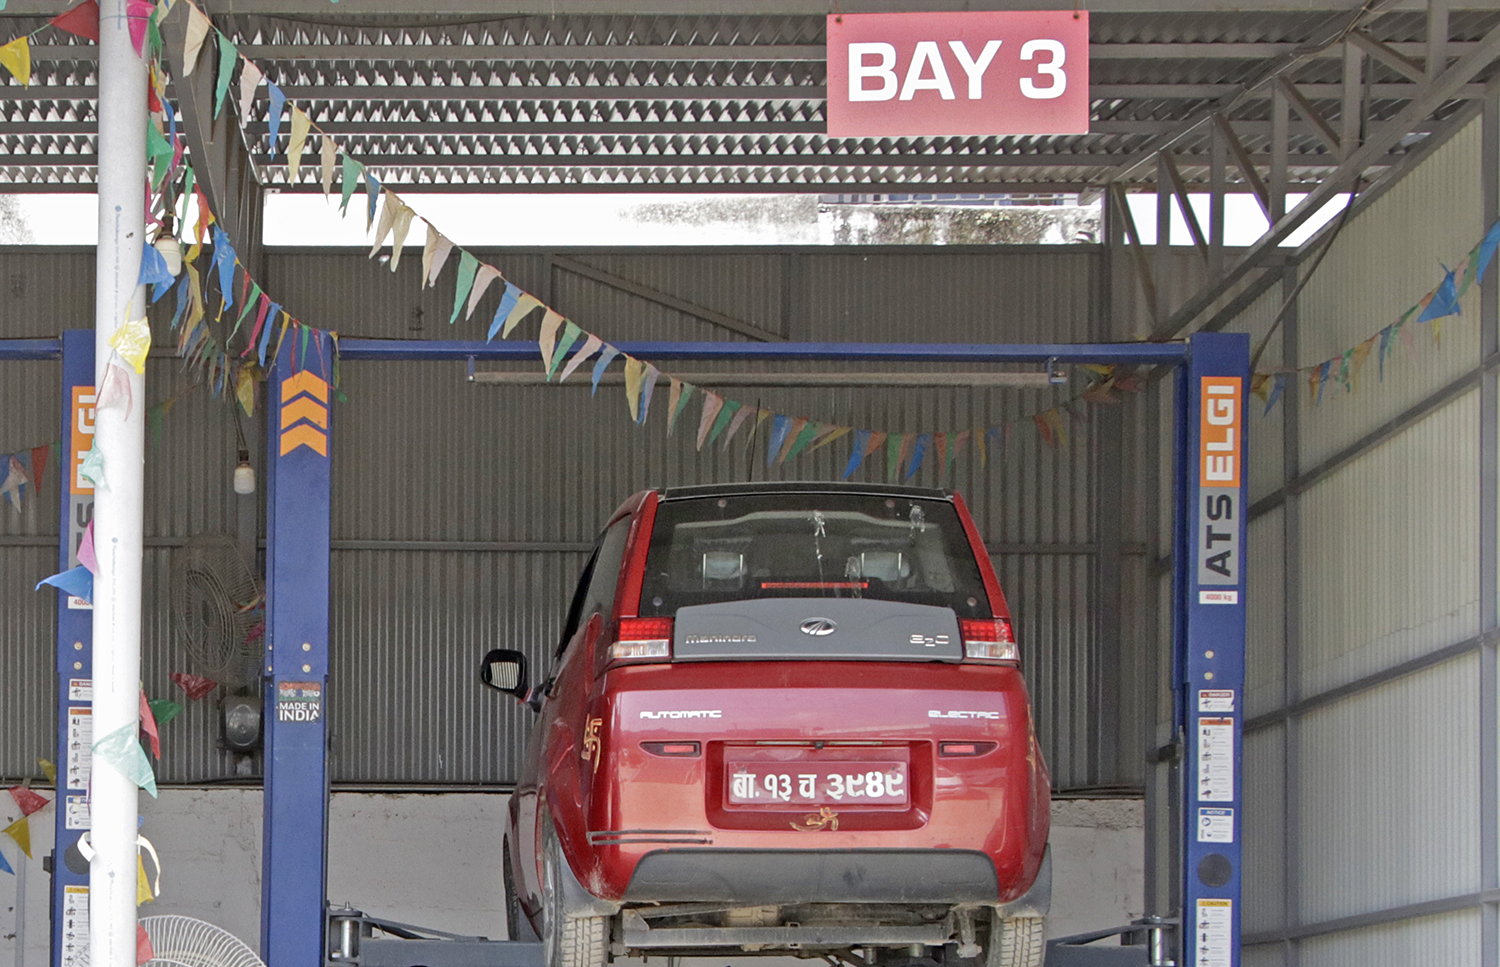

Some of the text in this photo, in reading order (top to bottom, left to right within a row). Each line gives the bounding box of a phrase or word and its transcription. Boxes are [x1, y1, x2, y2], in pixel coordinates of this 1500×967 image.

[848, 38, 1067, 102] BAY 3
[1204, 385, 1235, 578] ATS ELGI
[279, 702, 320, 711] MADE IN
[279, 710, 320, 721] INDIA
[639, 710, 723, 719] AUTOMATIC
[927, 710, 1000, 719] ELECTRIC
[764, 773, 793, 801] १३
[797, 774, 817, 799] च
